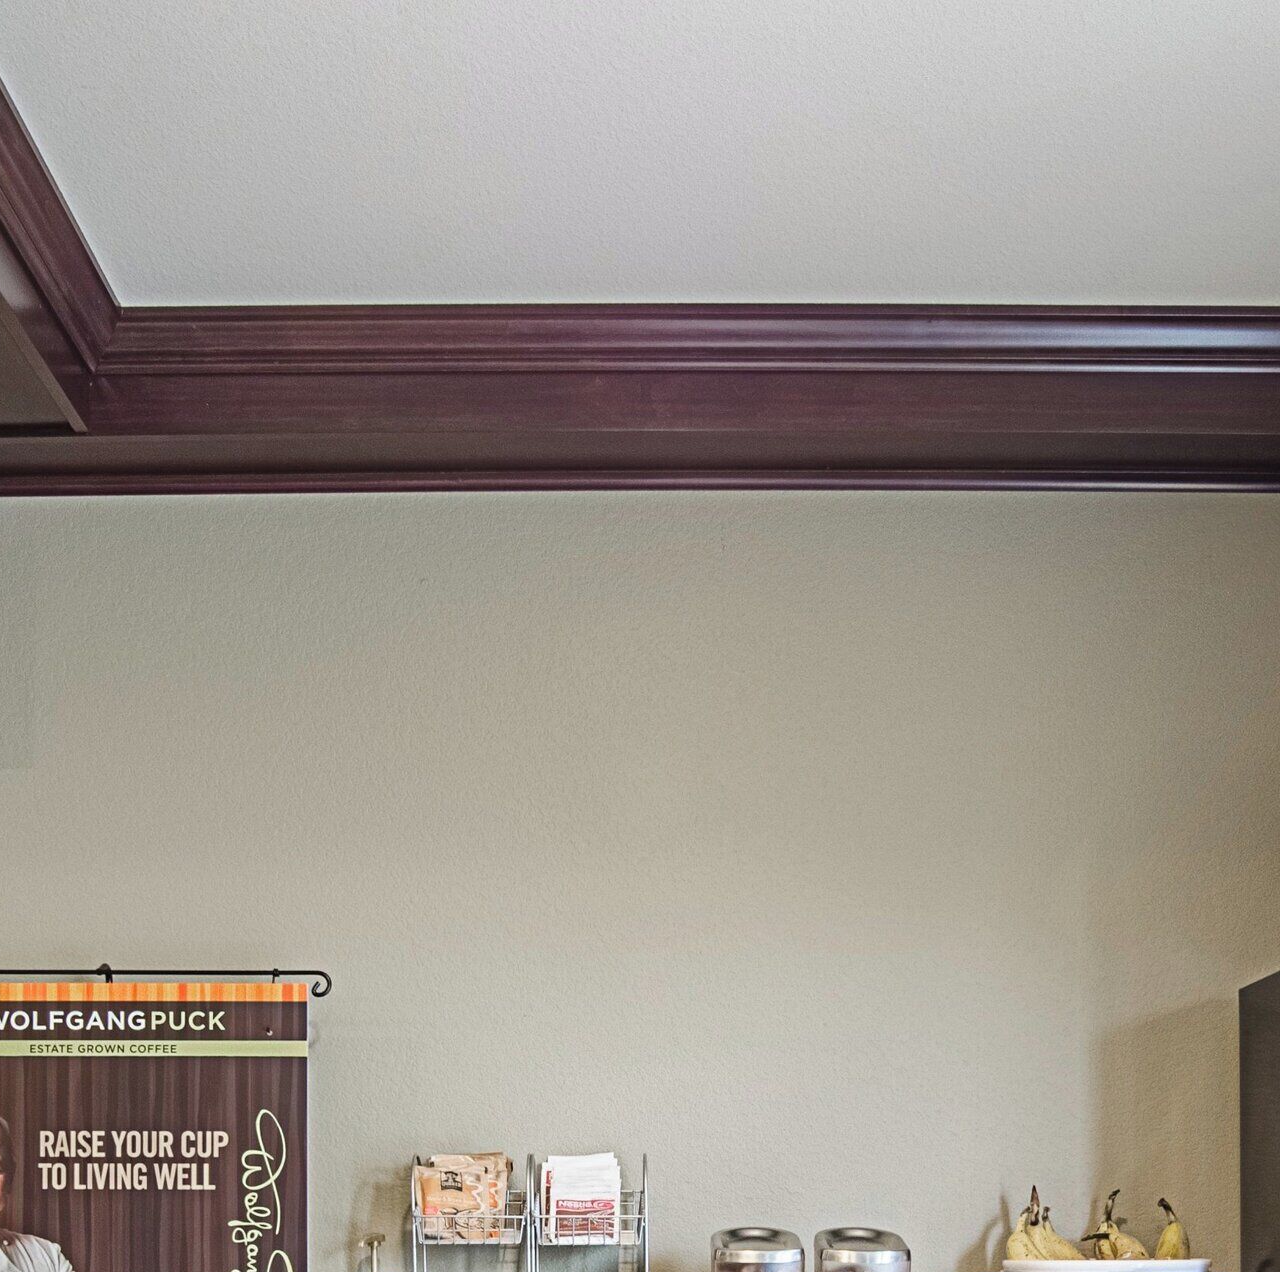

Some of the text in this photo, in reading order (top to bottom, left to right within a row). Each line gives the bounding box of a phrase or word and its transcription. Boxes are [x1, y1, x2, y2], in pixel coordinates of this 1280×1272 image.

[29, 1043, 177, 1054] ESTATE GROWN COFFEE
[39, 1130, 230, 1158] RAISE YOUR CUP
[37, 1162, 217, 1190] TO LIVING WELL
